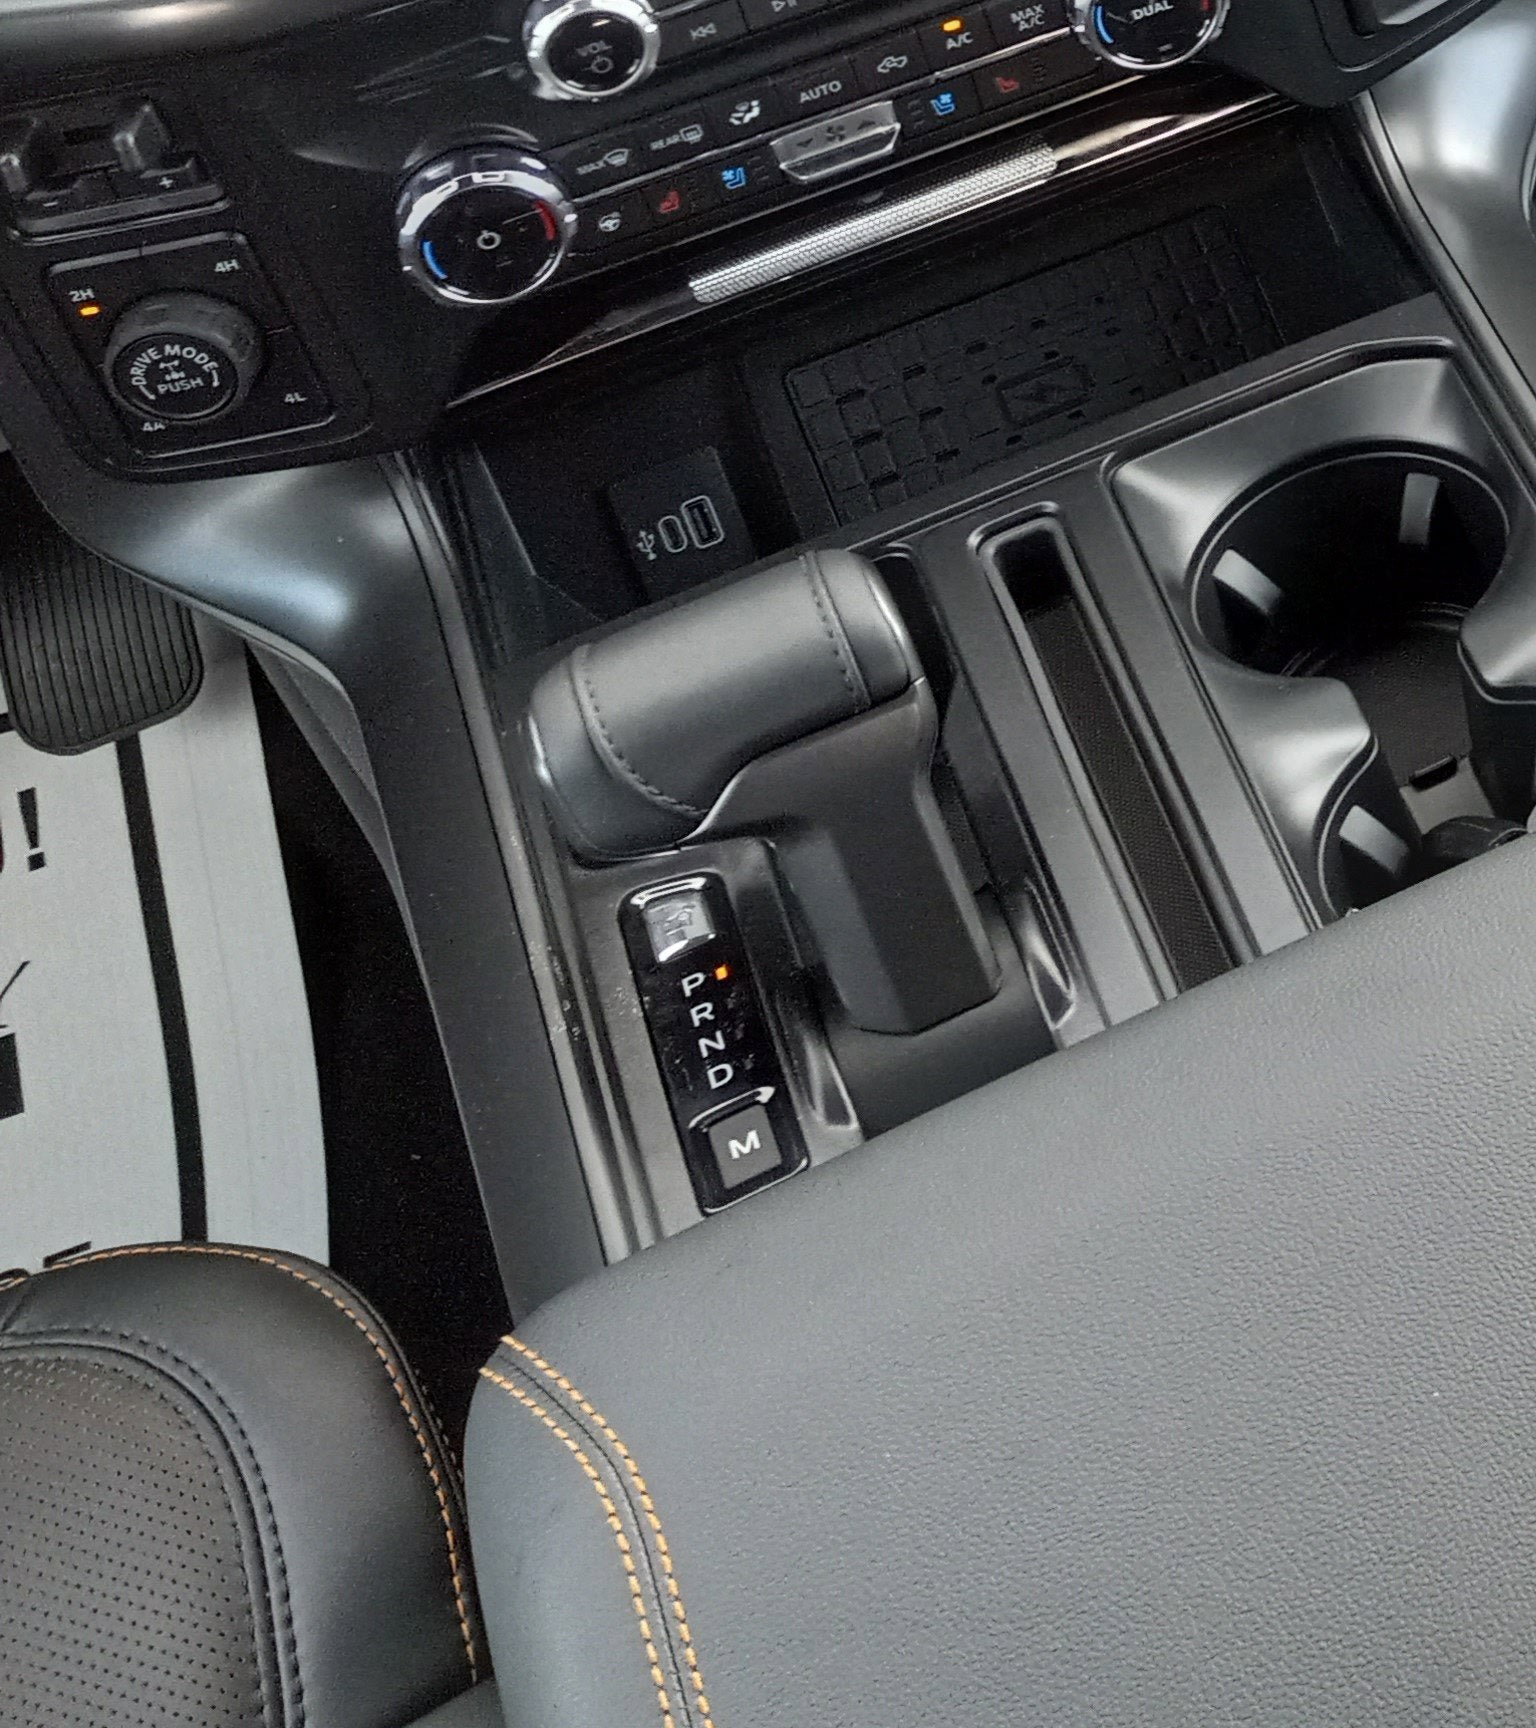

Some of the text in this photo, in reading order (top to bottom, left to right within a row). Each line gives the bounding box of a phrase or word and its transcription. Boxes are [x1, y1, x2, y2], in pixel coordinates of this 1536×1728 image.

[1010, 3, 1046, 24] MAX
[1131, 0, 1175, 22] DUAL
[1018, 13, 1046, 32] A/C
[946, 31, 974, 51] A/C
[799, 80, 842, 104] AUTO
[214, 258, 240, 273] 4H
[69, 288, 95, 302] 2H
[130, 343, 219, 386] DRIVE MODE
[156, 376, 205, 395] PUSH
[284, 391, 307, 404] 4L
[681, 972, 707, 998] P
[689, 1002, 716, 1028] R
[698, 1030, 726, 1059] N
[706, 1062, 734, 1090] D
[728, 1129, 762, 1160] M
